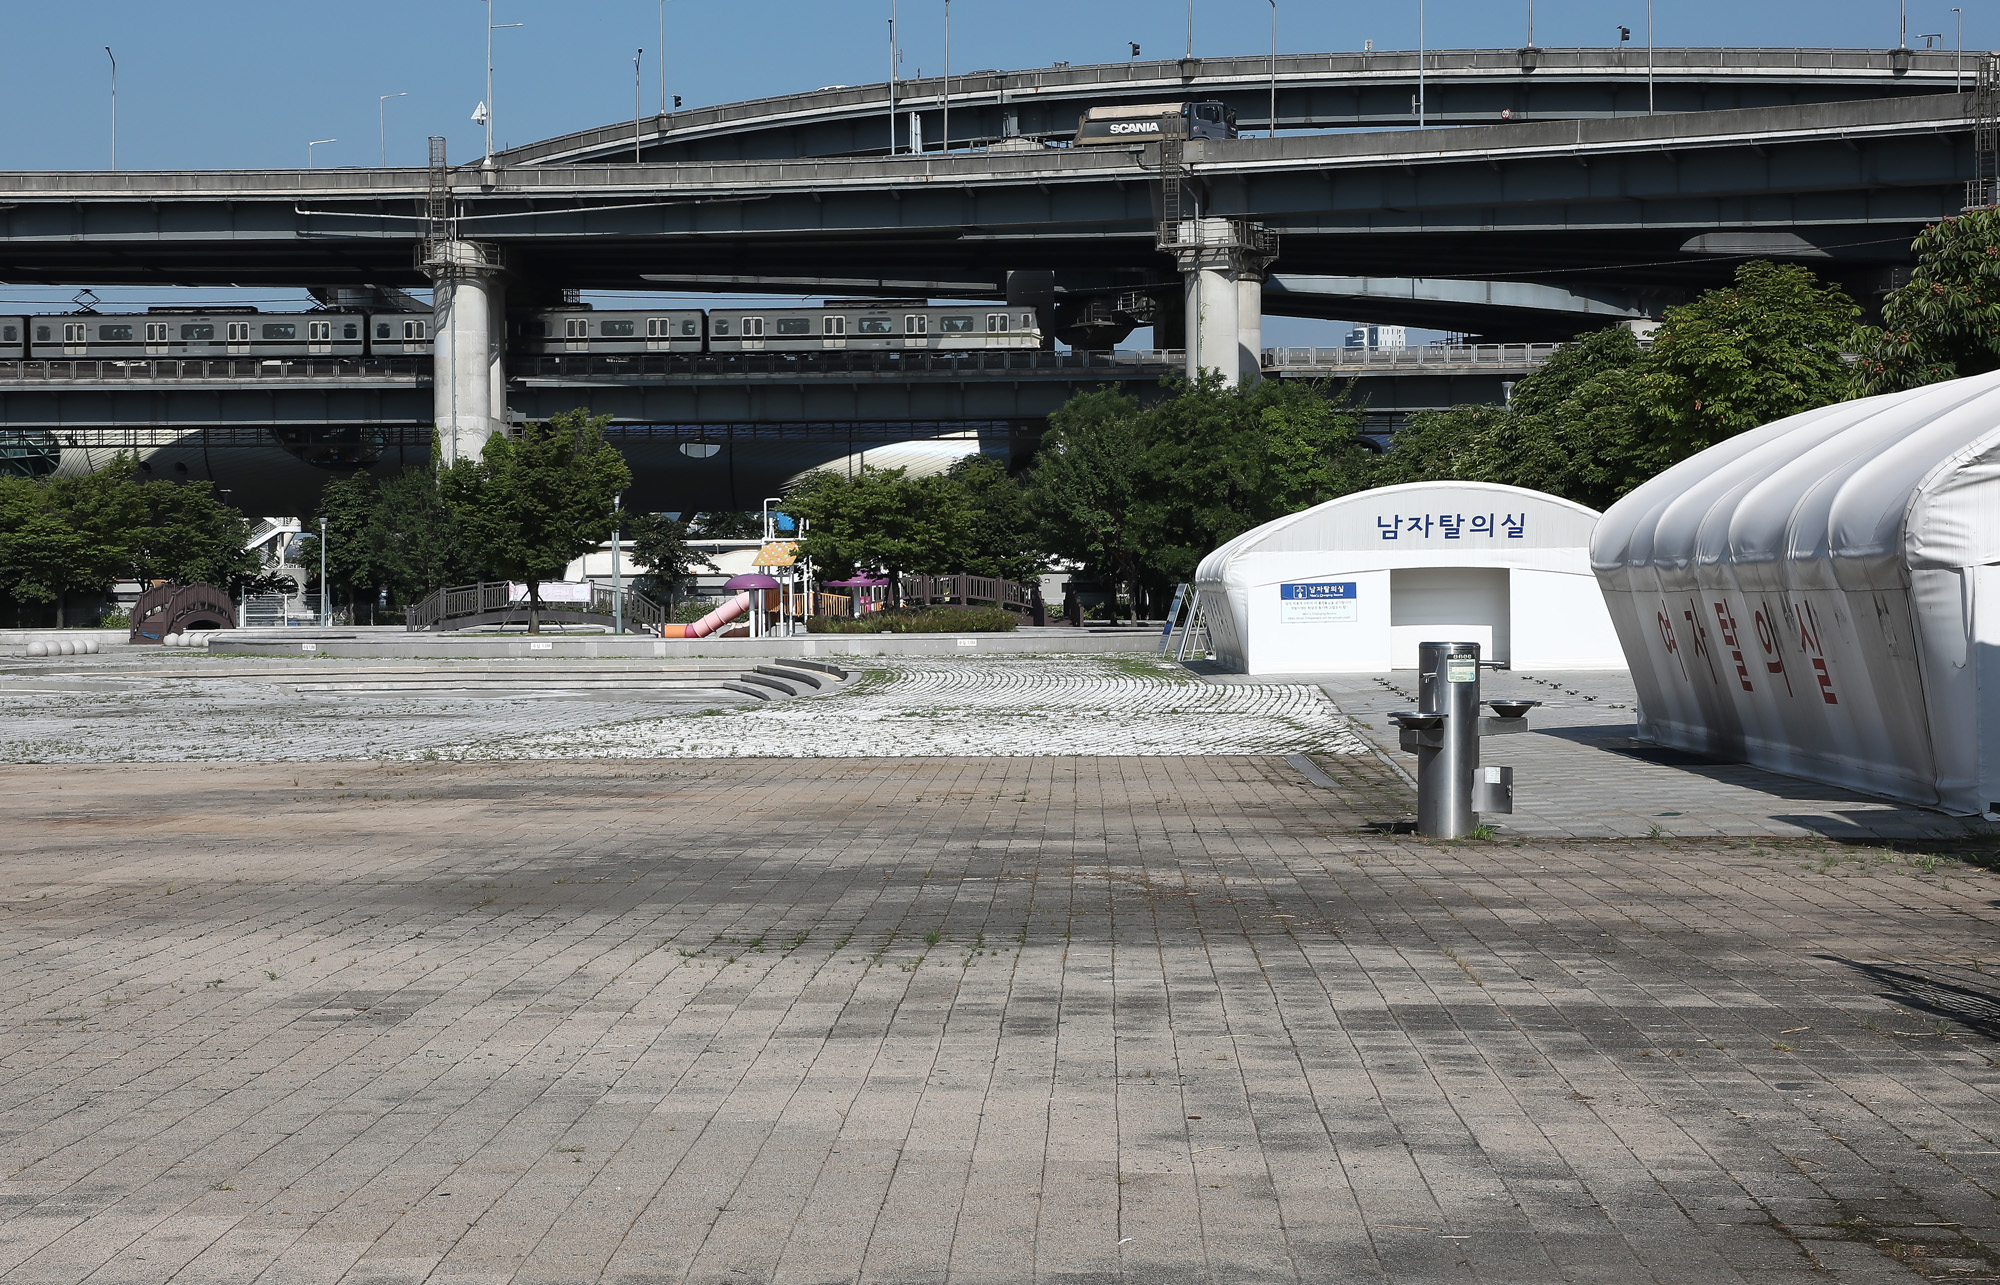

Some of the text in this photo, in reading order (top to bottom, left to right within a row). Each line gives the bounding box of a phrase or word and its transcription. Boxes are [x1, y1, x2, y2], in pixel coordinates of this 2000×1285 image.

[1109, 122, 1160, 134] SCANIA
[1377, 512, 1526, 540] 남자탈의실
[1309, 585, 1344, 594] 남자탈의실
[1657, 598, 1839, 705] 여자탈의실
